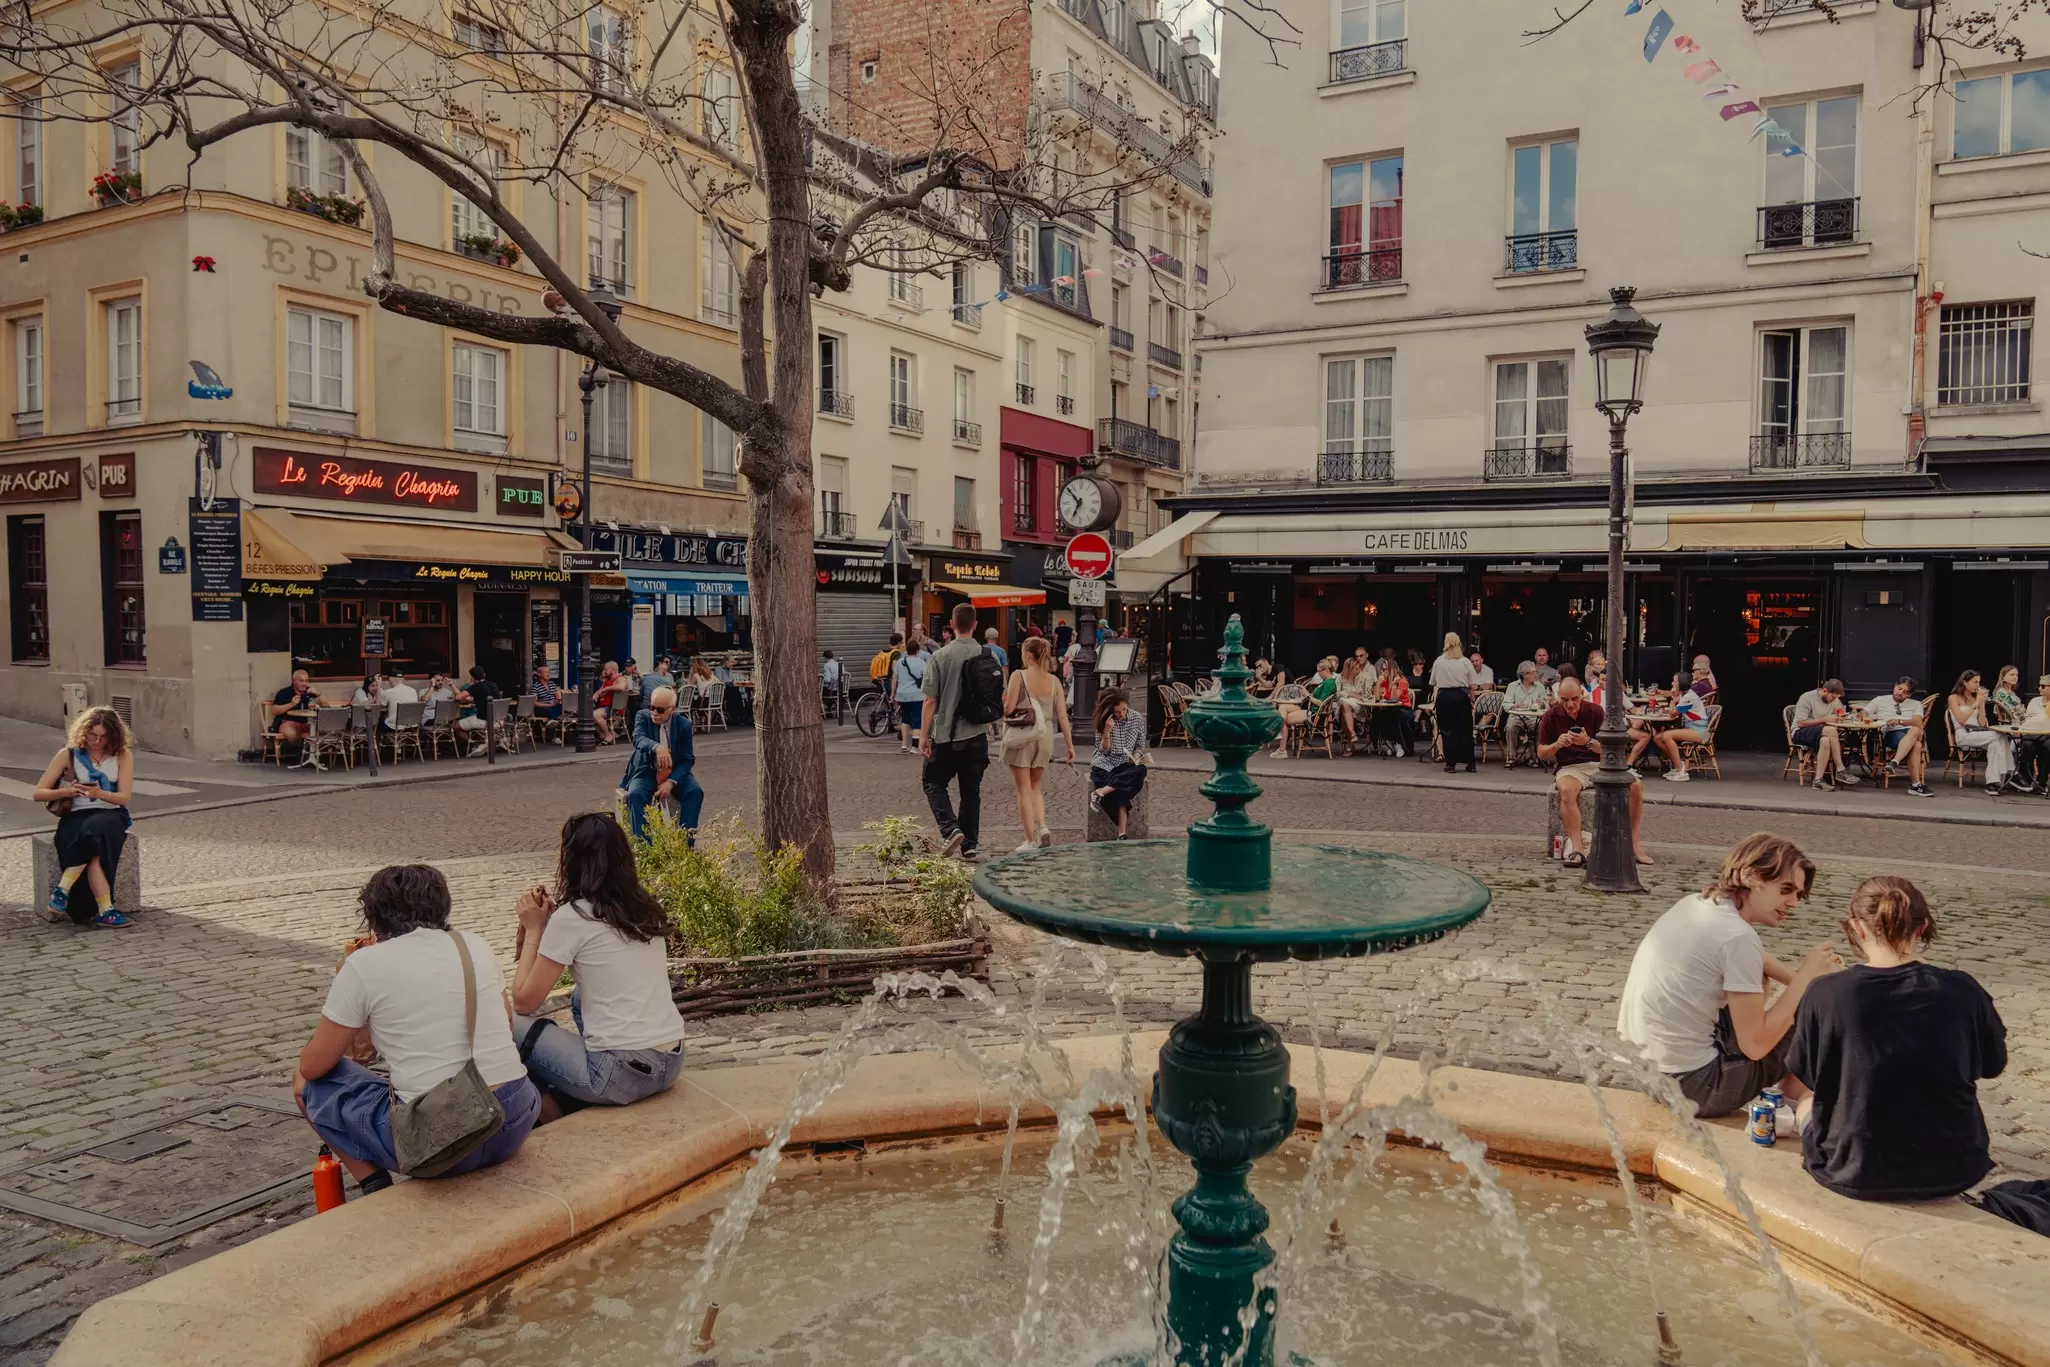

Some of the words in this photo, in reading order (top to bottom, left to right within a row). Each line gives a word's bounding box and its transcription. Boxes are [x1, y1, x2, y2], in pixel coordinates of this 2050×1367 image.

[0, 470, 69, 494] HAGRIN
[102, 465, 126, 485] PUB
[280, 456, 307, 483] Le
[321, 462, 384, 495] Requin
[395, 470, 460, 502] Chagrin
[502, 488, 544, 505] PUB
[1365, 534, 1410, 549] CAFE
[1414, 531, 1468, 550] DELMAS
[246, 542, 261, 558] 12
[674, 537, 708, 564] DE
[275, 564, 316, 574] PRESSION
[1044, 553, 1054, 569] Le
[416, 566, 428, 576] Le
[430, 567, 457, 579] Requin
[459, 568, 489, 580] Chagrin
[510, 570, 542, 581] HAPPY
[544, 571, 571, 582] HOUR
[248, 582, 259, 593] Le
[260, 583, 284, 597] Requin
[286, 584, 314, 598] Chagrin
[696, 582, 734, 594] TRAITEUR
